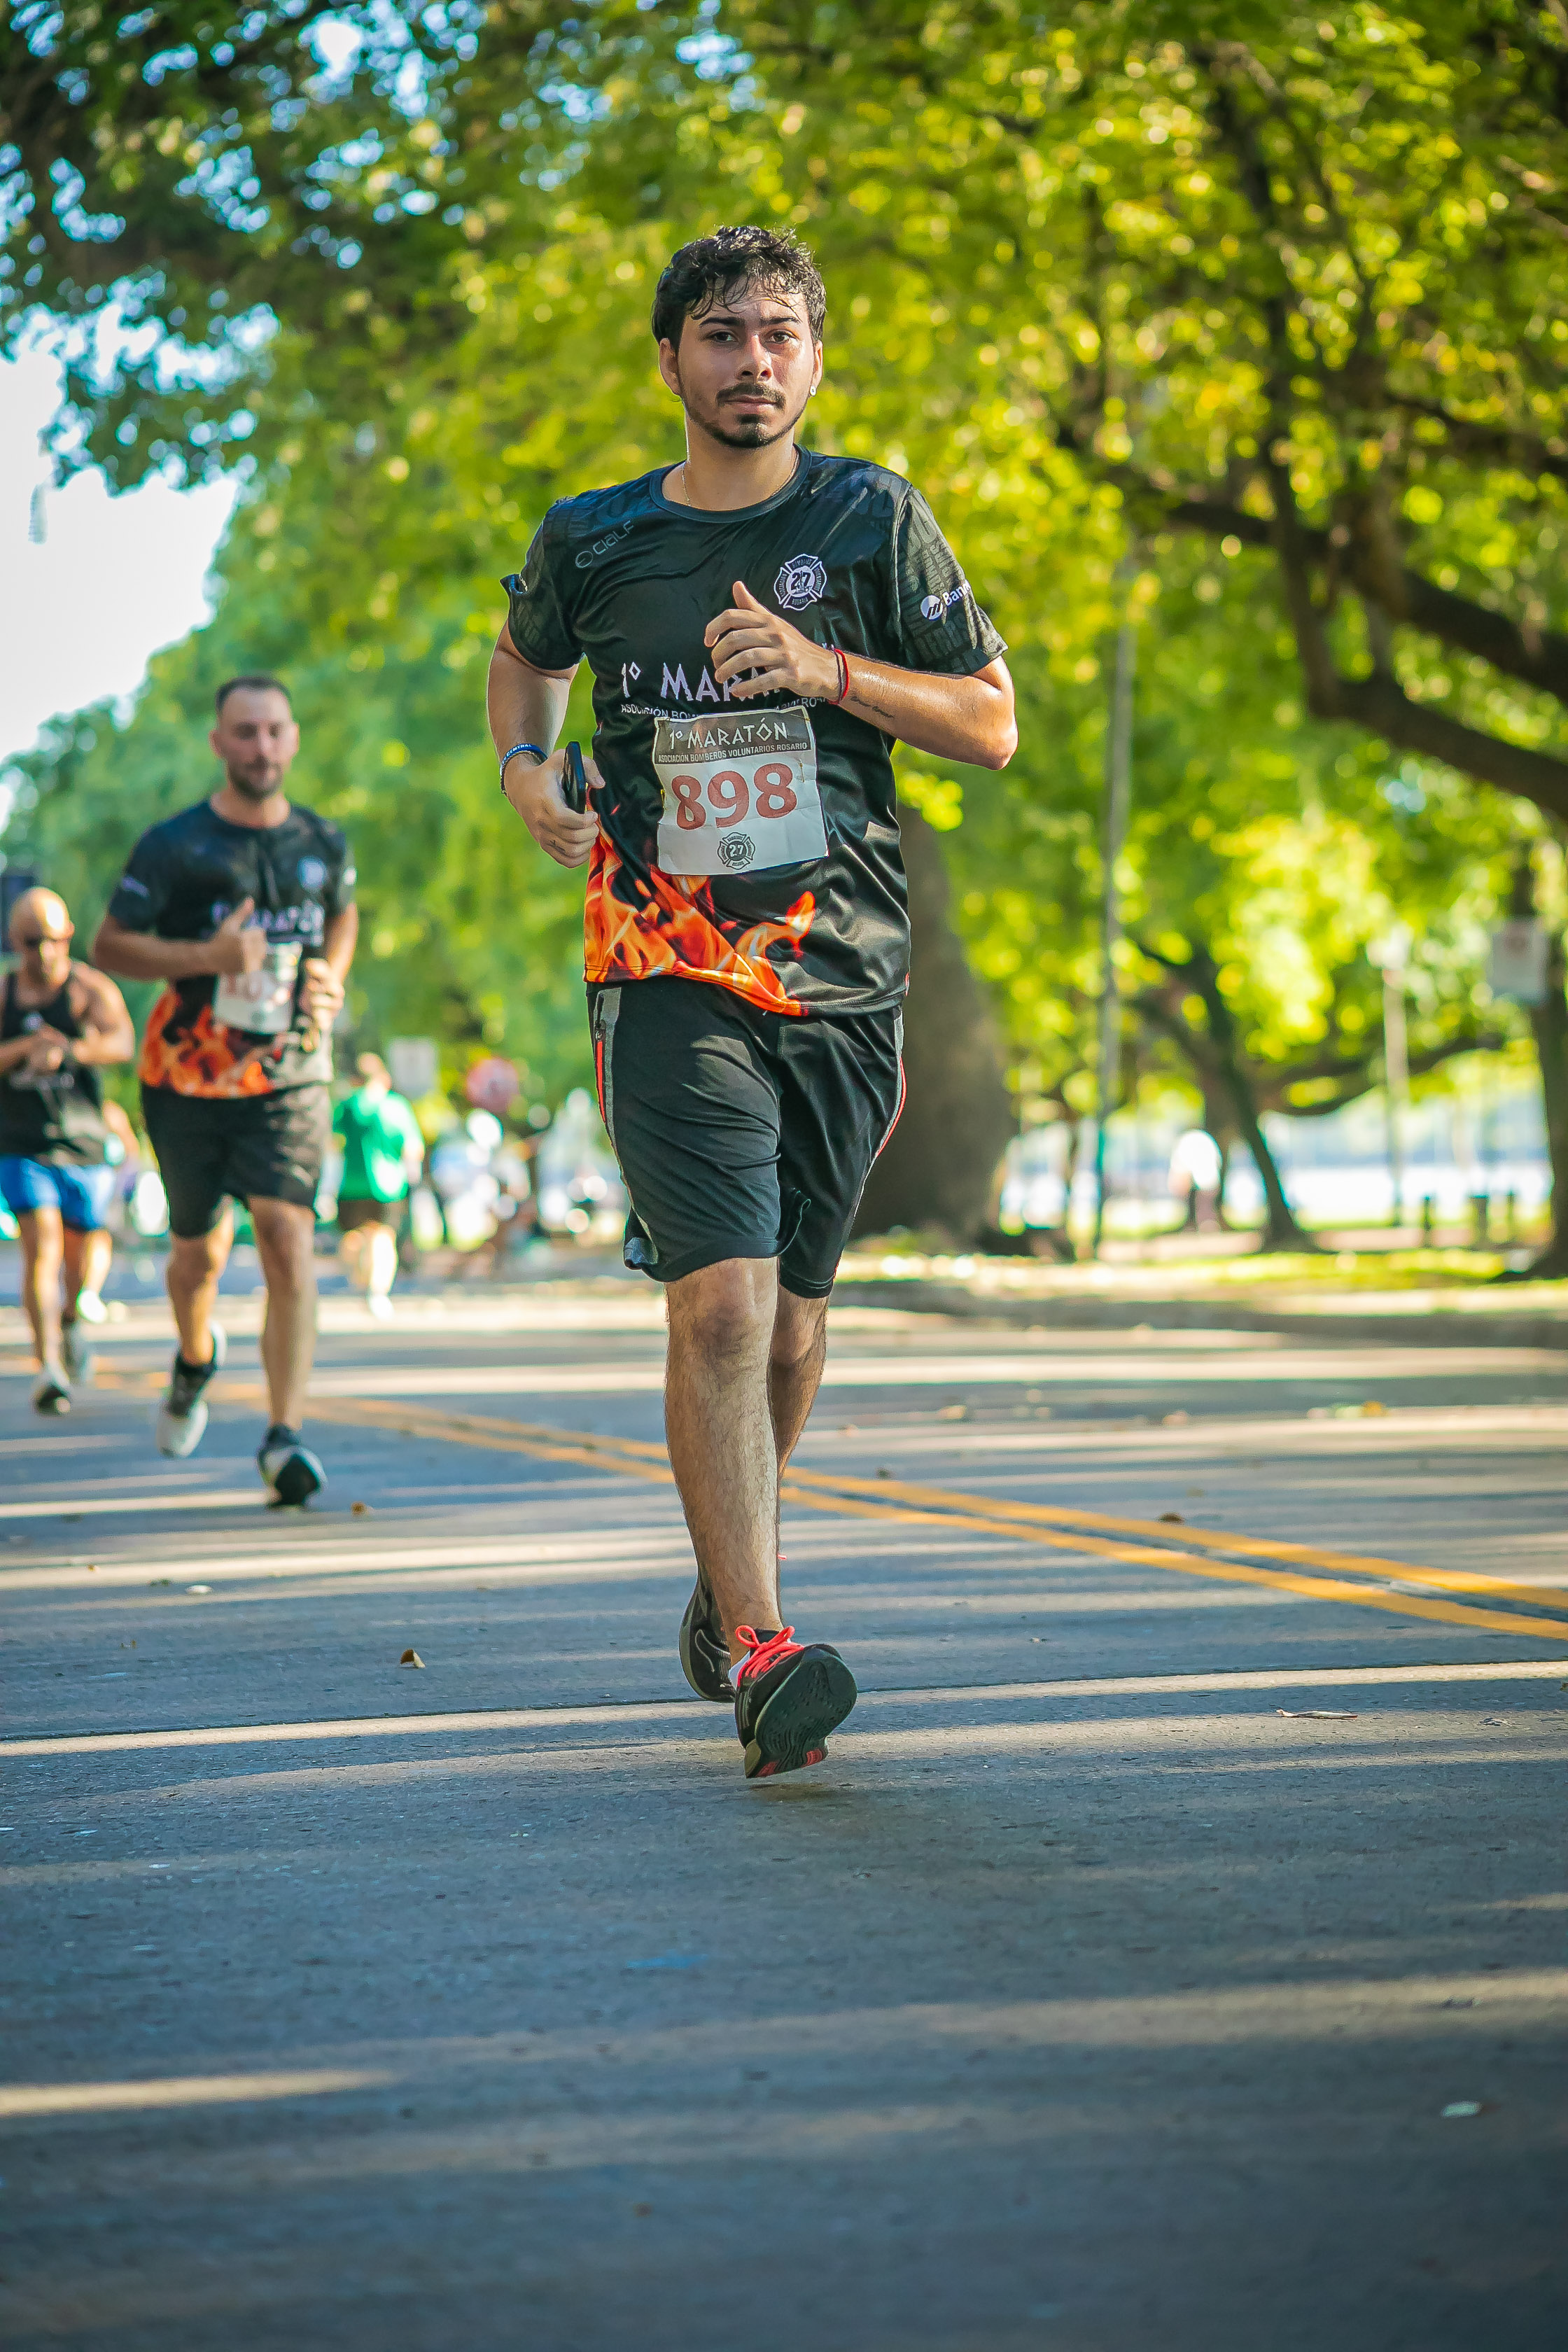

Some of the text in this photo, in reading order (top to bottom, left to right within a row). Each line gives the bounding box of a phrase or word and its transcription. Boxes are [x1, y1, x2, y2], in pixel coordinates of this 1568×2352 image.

[790, 571, 812, 592] 27
[687, 717, 788, 749] MARATÓN
[658, 742, 808, 763] ASOCIACIÓN BOMBEROS VOLUNTARIOS ROSARIO
[671, 762, 797, 830] 898
[729, 844, 744, 858] 27
